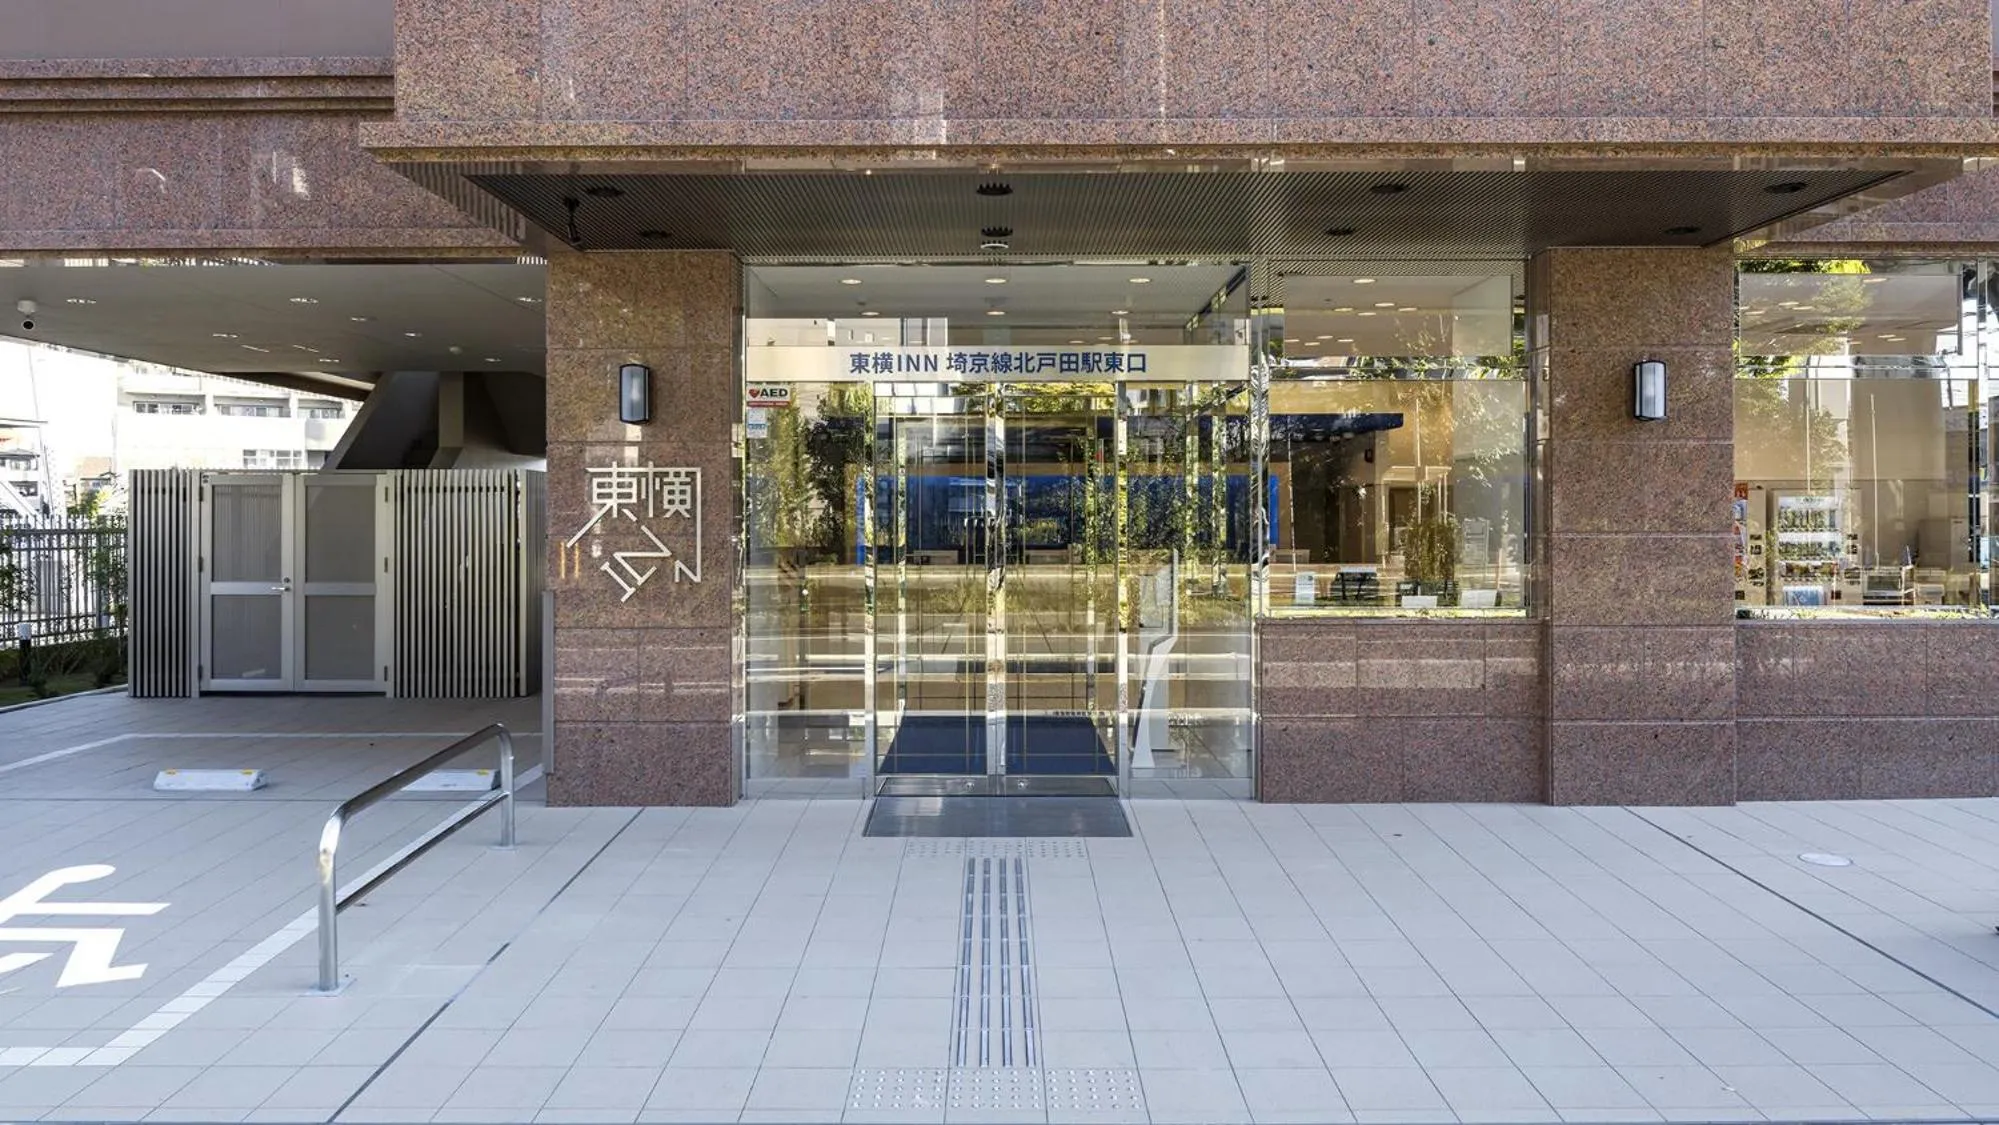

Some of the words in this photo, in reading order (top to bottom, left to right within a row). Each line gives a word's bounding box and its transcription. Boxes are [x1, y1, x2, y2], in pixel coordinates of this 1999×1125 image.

[850, 351, 938, 374] 東横INN
[946, 351, 1147, 374] 埼京線北戸田駅東口
[760, 388, 788, 397] AED
